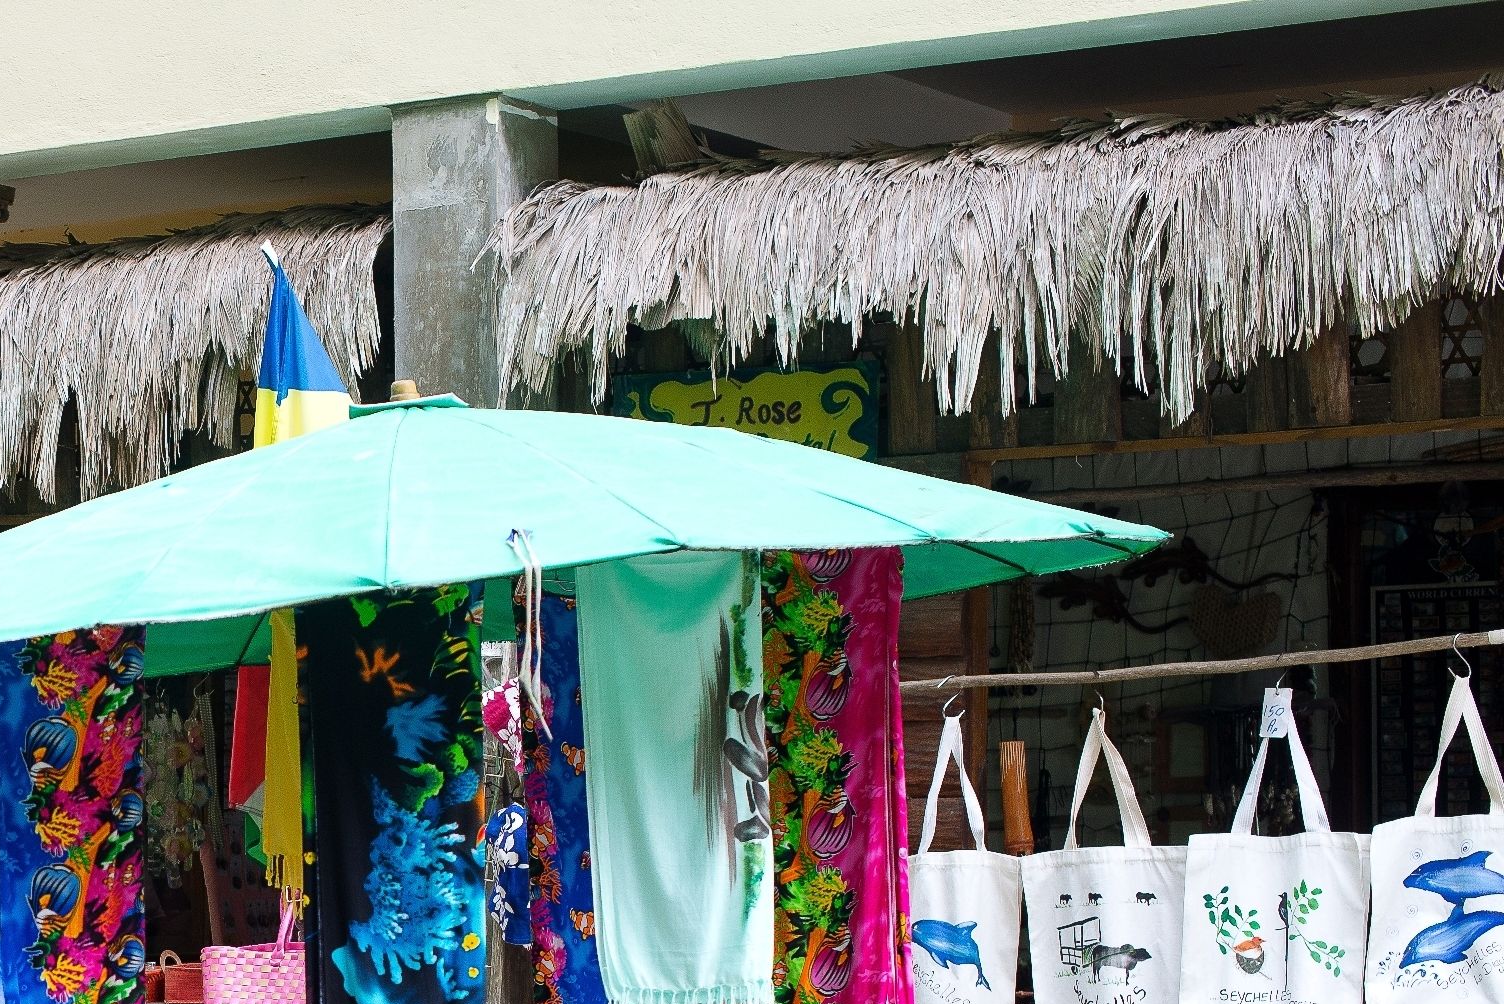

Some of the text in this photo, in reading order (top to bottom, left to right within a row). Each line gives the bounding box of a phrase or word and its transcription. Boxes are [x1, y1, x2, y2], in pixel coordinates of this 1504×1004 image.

[736, 396, 802, 425] Rose
[1407, 589, 1447, 599] WORLD
[1264, 704, 1285, 717] 150
